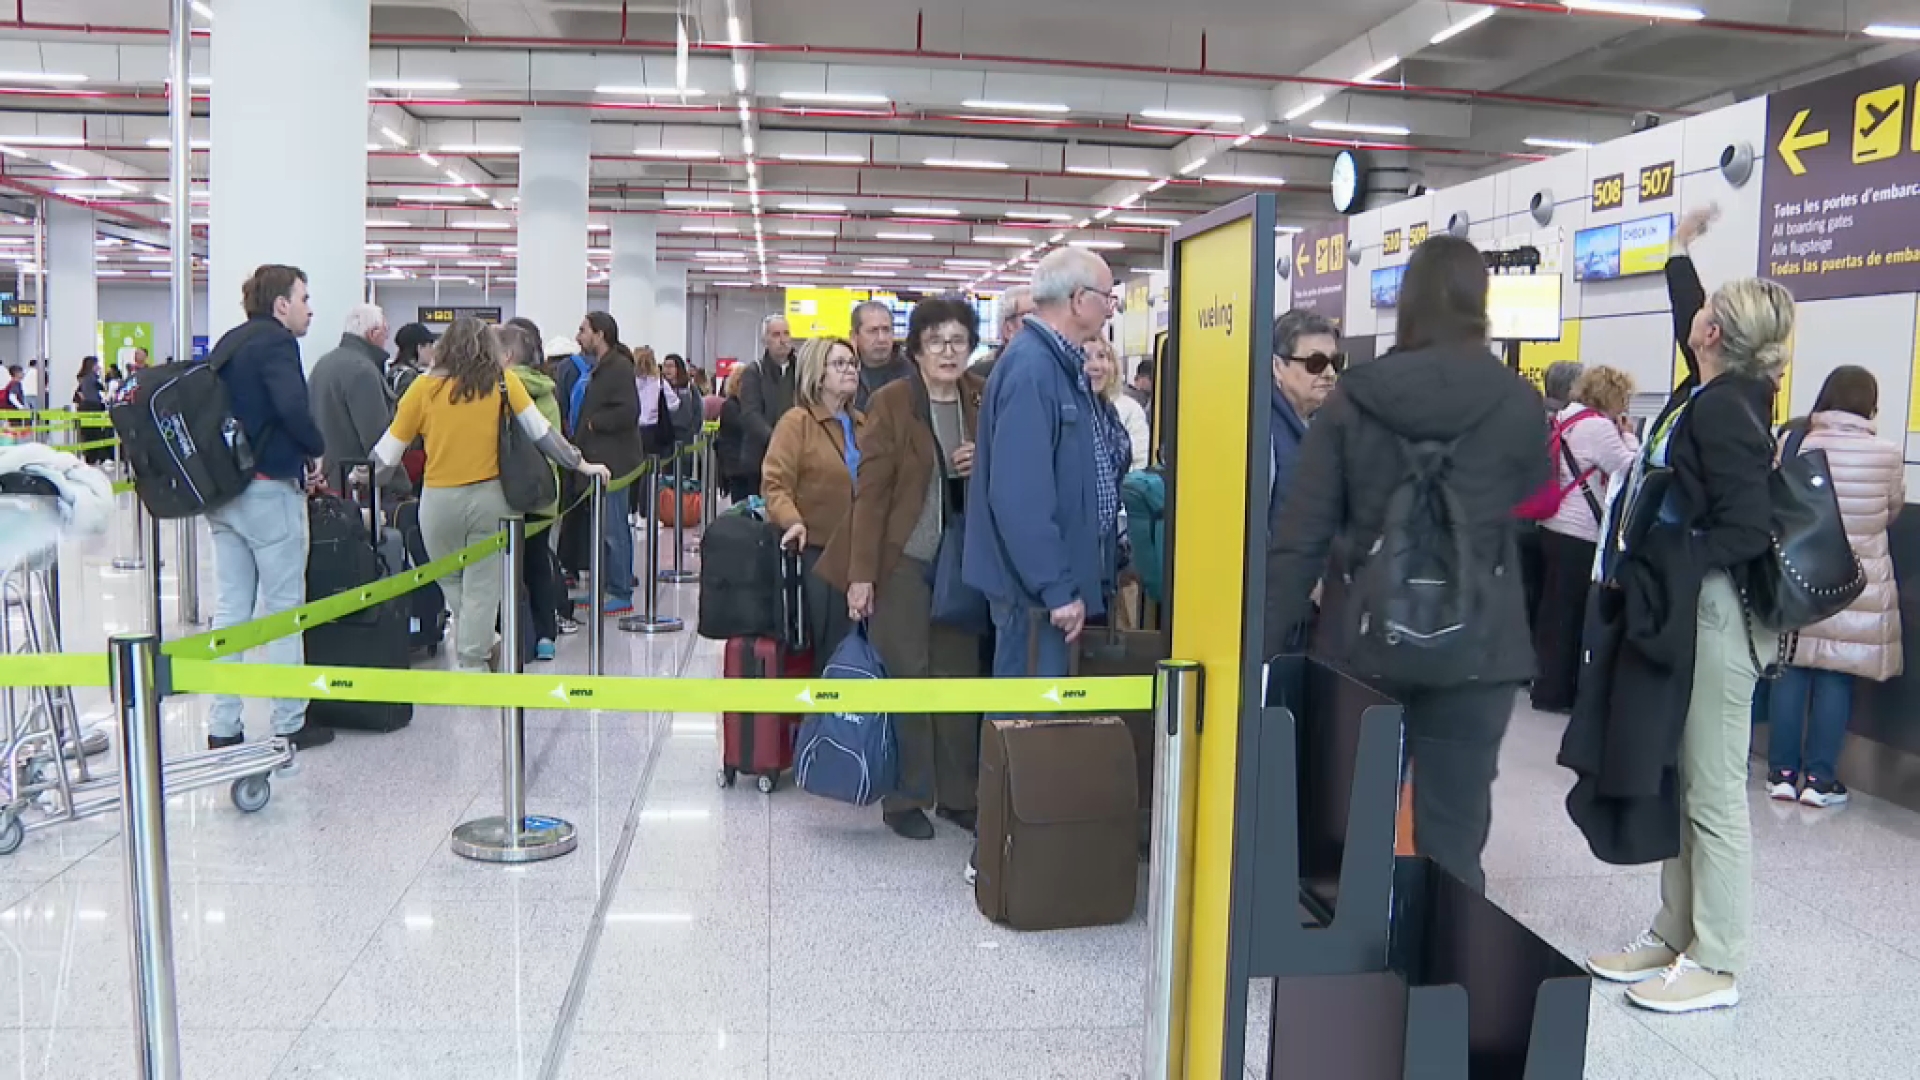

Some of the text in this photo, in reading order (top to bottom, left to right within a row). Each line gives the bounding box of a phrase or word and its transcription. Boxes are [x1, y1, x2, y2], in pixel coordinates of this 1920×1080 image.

[1593, 179, 1621, 207] 508
[1642, 166, 1672, 197] 507
[1773, 183, 1920, 218] Totes les portes d'embarc
[1772, 214, 1854, 238] All boarding gates
[1771, 242, 1787, 256] Alle
[1770, 261, 1800, 276] Todas
[1803, 258, 1819, 274] las
[1821, 254, 1863, 274] puertas
[1866, 250, 1882, 267] de
[1198, 293, 1232, 336] vueling
[329, 679, 353, 689] aena
[569, 687, 593, 697] aena
[815, 690, 839, 700] aena
[1062, 687, 1086, 699] aena
